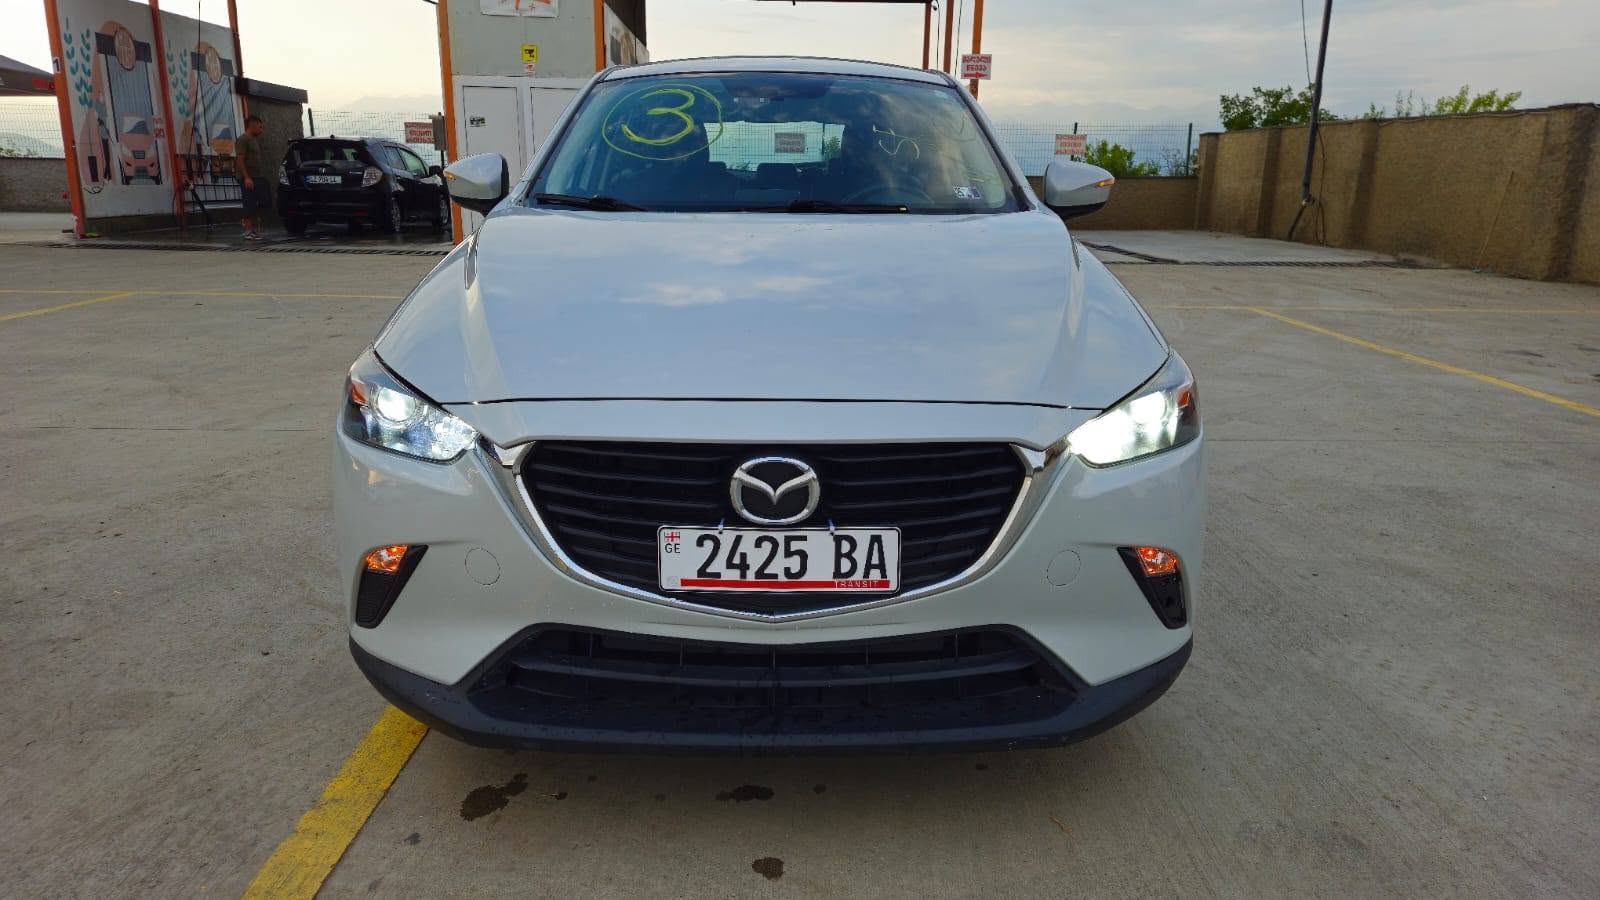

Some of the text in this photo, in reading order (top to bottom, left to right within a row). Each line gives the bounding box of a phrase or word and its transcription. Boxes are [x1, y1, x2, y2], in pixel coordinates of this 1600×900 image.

[620, 88, 695, 146] 3
[664, 543, 681, 554] GE
[696, 533, 888, 580] 2425 BA
[834, 579, 879, 589] TRANSIT
